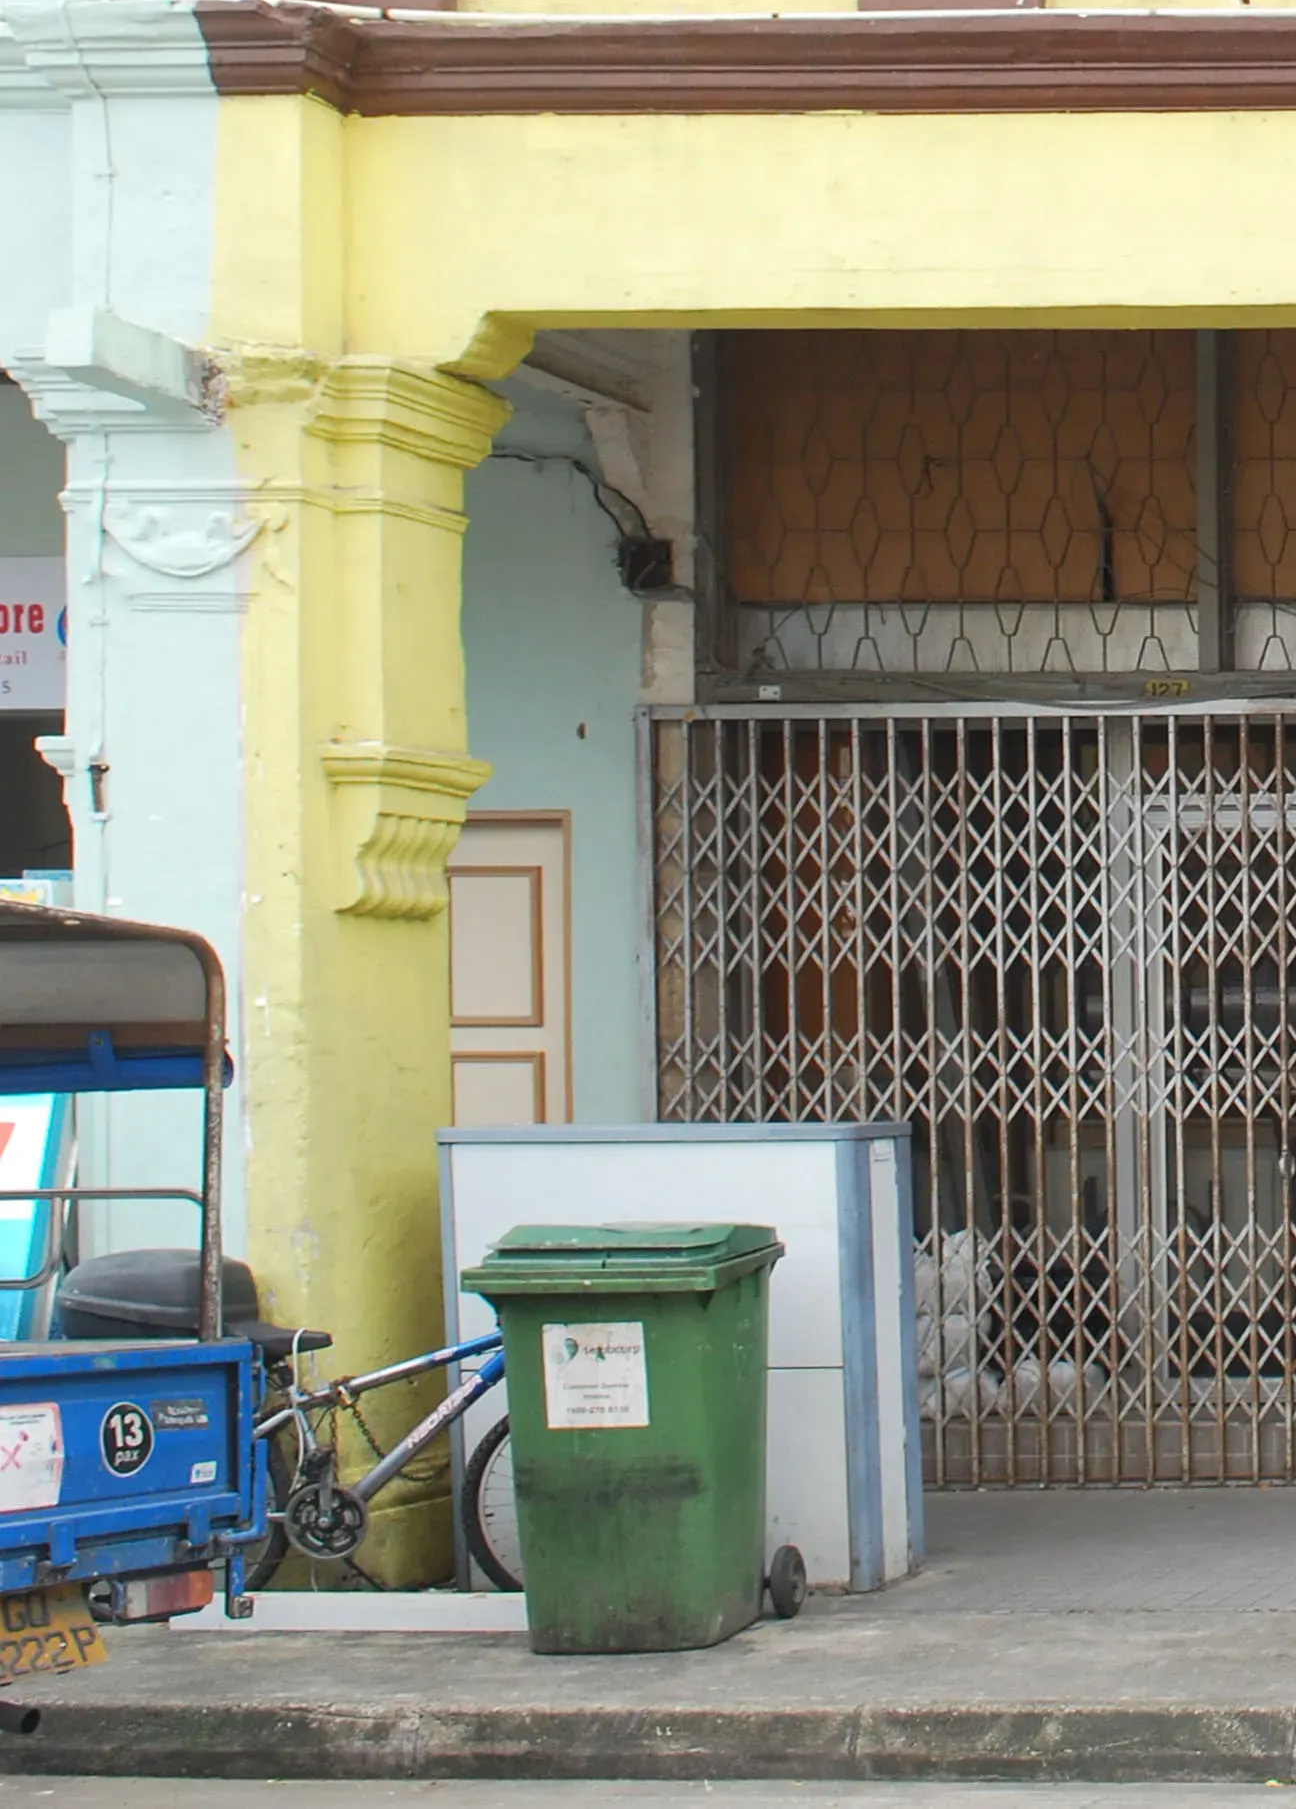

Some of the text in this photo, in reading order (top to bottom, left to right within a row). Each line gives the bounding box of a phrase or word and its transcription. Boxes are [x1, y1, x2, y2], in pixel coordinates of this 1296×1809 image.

[1151, 682, 1183, 697] 127
[109, 1412, 144, 1448] 13
[114, 1449, 140, 1466] pax
[0, 1625, 96, 1678] 222P
